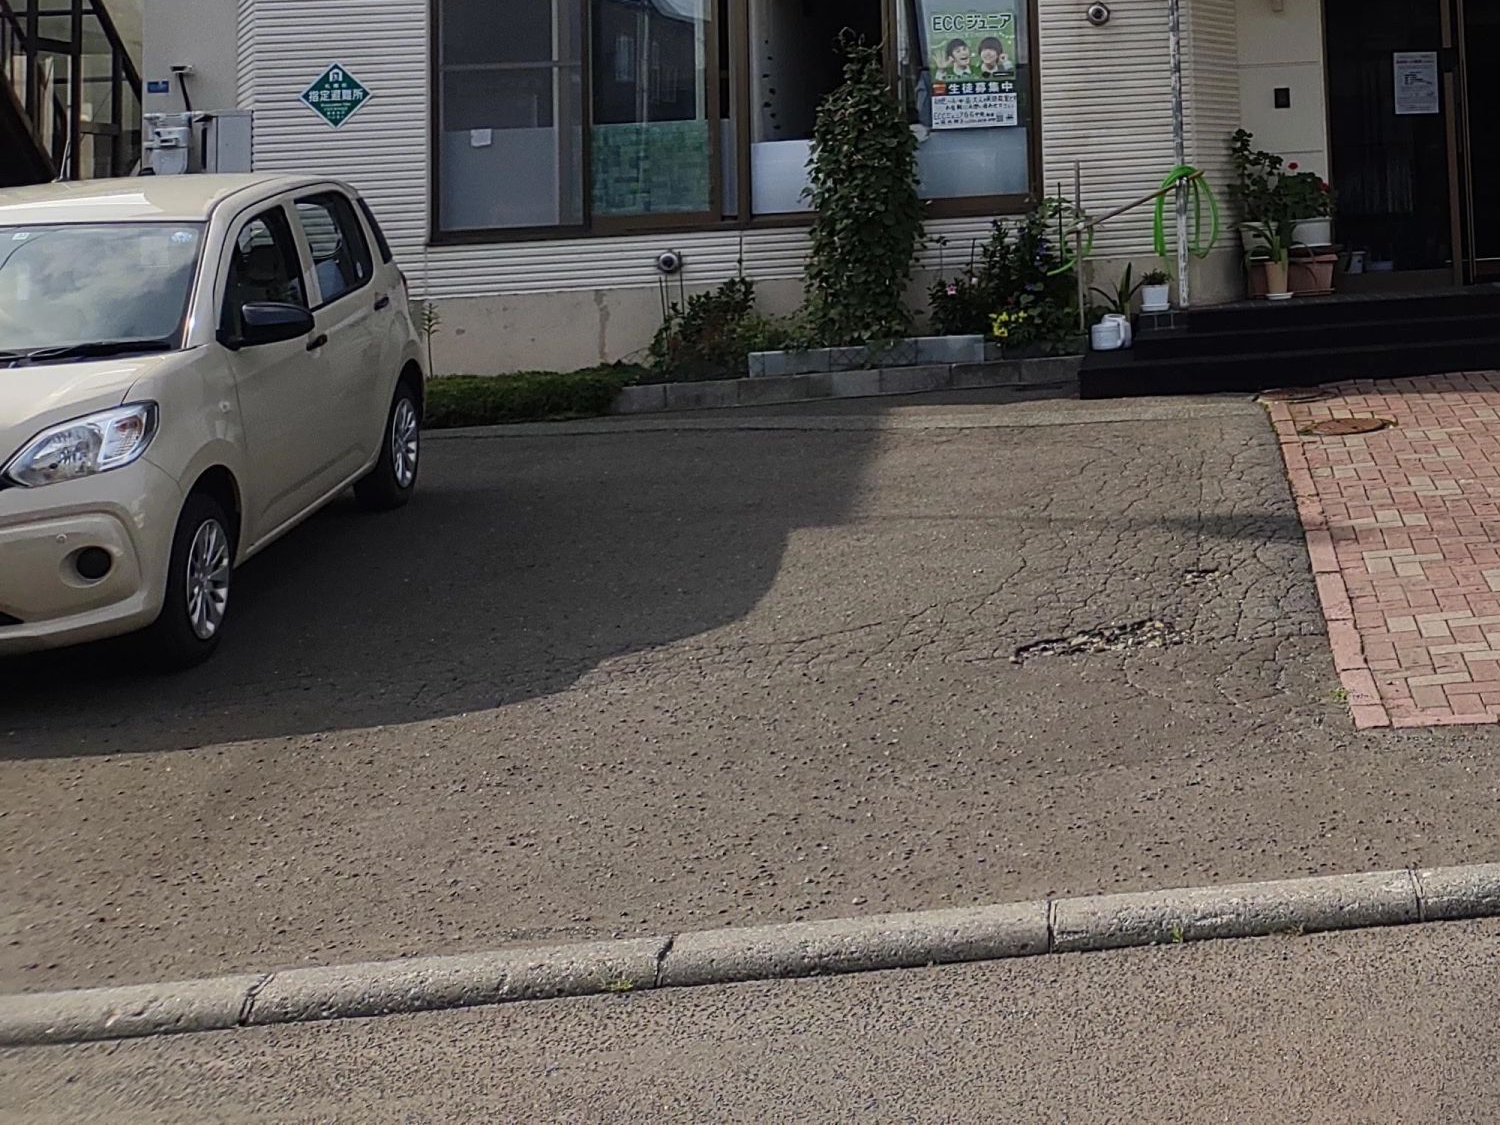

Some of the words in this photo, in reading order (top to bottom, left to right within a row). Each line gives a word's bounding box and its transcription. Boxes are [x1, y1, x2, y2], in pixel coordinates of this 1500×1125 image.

[932, 14, 1012, 31] ECCジュニア
[948, 81, 1013, 94] 生徒募集中
[308, 88, 364, 102] 指定避難所
